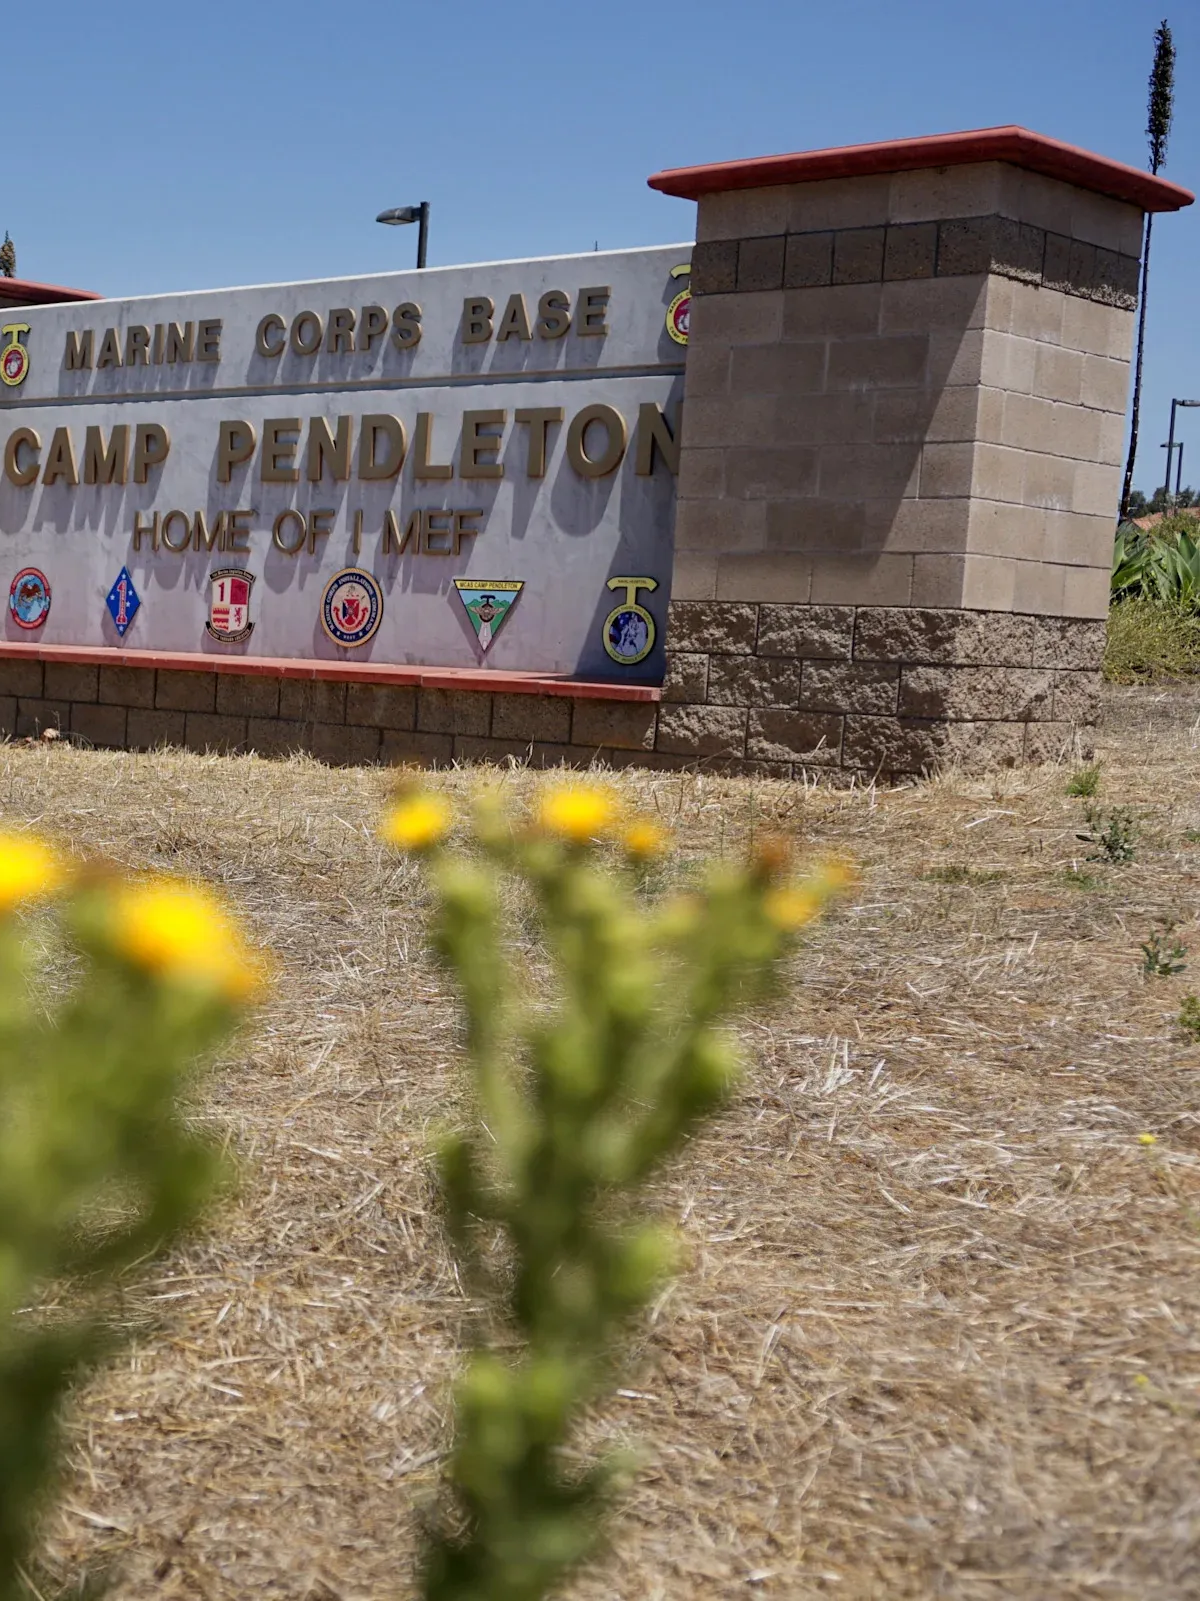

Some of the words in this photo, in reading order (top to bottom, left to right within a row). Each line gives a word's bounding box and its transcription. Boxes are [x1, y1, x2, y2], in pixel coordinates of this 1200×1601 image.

[65, 318, 224, 371] MARINE
[255, 301, 423, 358] CORPS
[461, 285, 612, 345] BASE
[4, 423, 172, 487] CAMP
[216, 402, 681, 484] PENDLETON
[132, 508, 256, 554] HOME
[272, 508, 335, 555] OF
[353, 508, 364, 555] I
[381, 508, 484, 556] MEF
[218, 582, 225, 602] 1
[326, 582, 339, 603] CORPS
[338, 575, 374, 595] INSTALLATIONS
[116, 580, 128, 625] 1
[325, 604, 336, 631] MARINE
[365, 597, 377, 631] COMMAND
